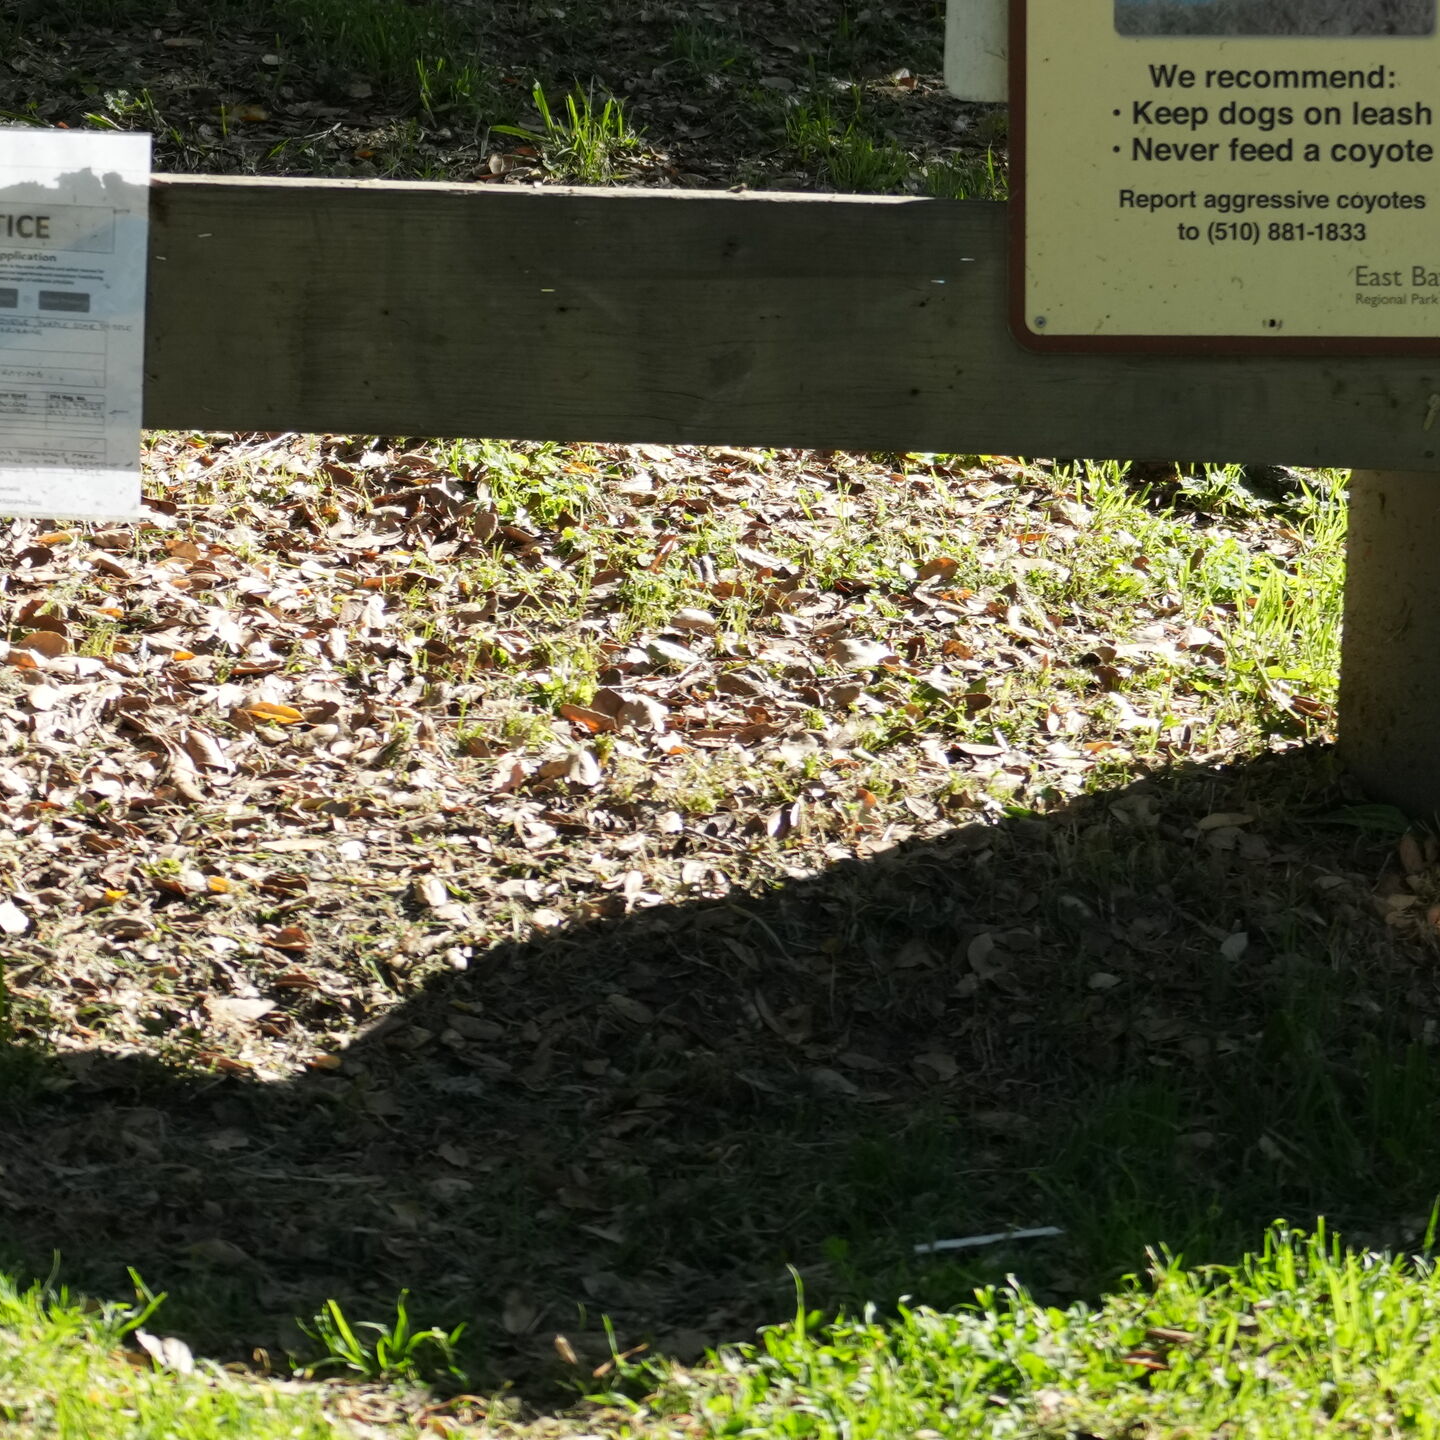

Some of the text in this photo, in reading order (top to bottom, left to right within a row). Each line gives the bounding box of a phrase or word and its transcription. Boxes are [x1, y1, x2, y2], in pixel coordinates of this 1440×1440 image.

[1149, 64, 1395, 89] We recommend:
[1132, 100, 1432, 130] Keep dogs on leash
[1131, 137, 1433, 168] Never feed a coyote
[1119, 190, 1426, 214] Report aggressive coyotes
[1178, 222, 1366, 244] to (510) 881-1833
[1354, 265, 1402, 286] East
[1355, 293, 1407, 307] Regional
[1410, 293, 1438, 304] Park
